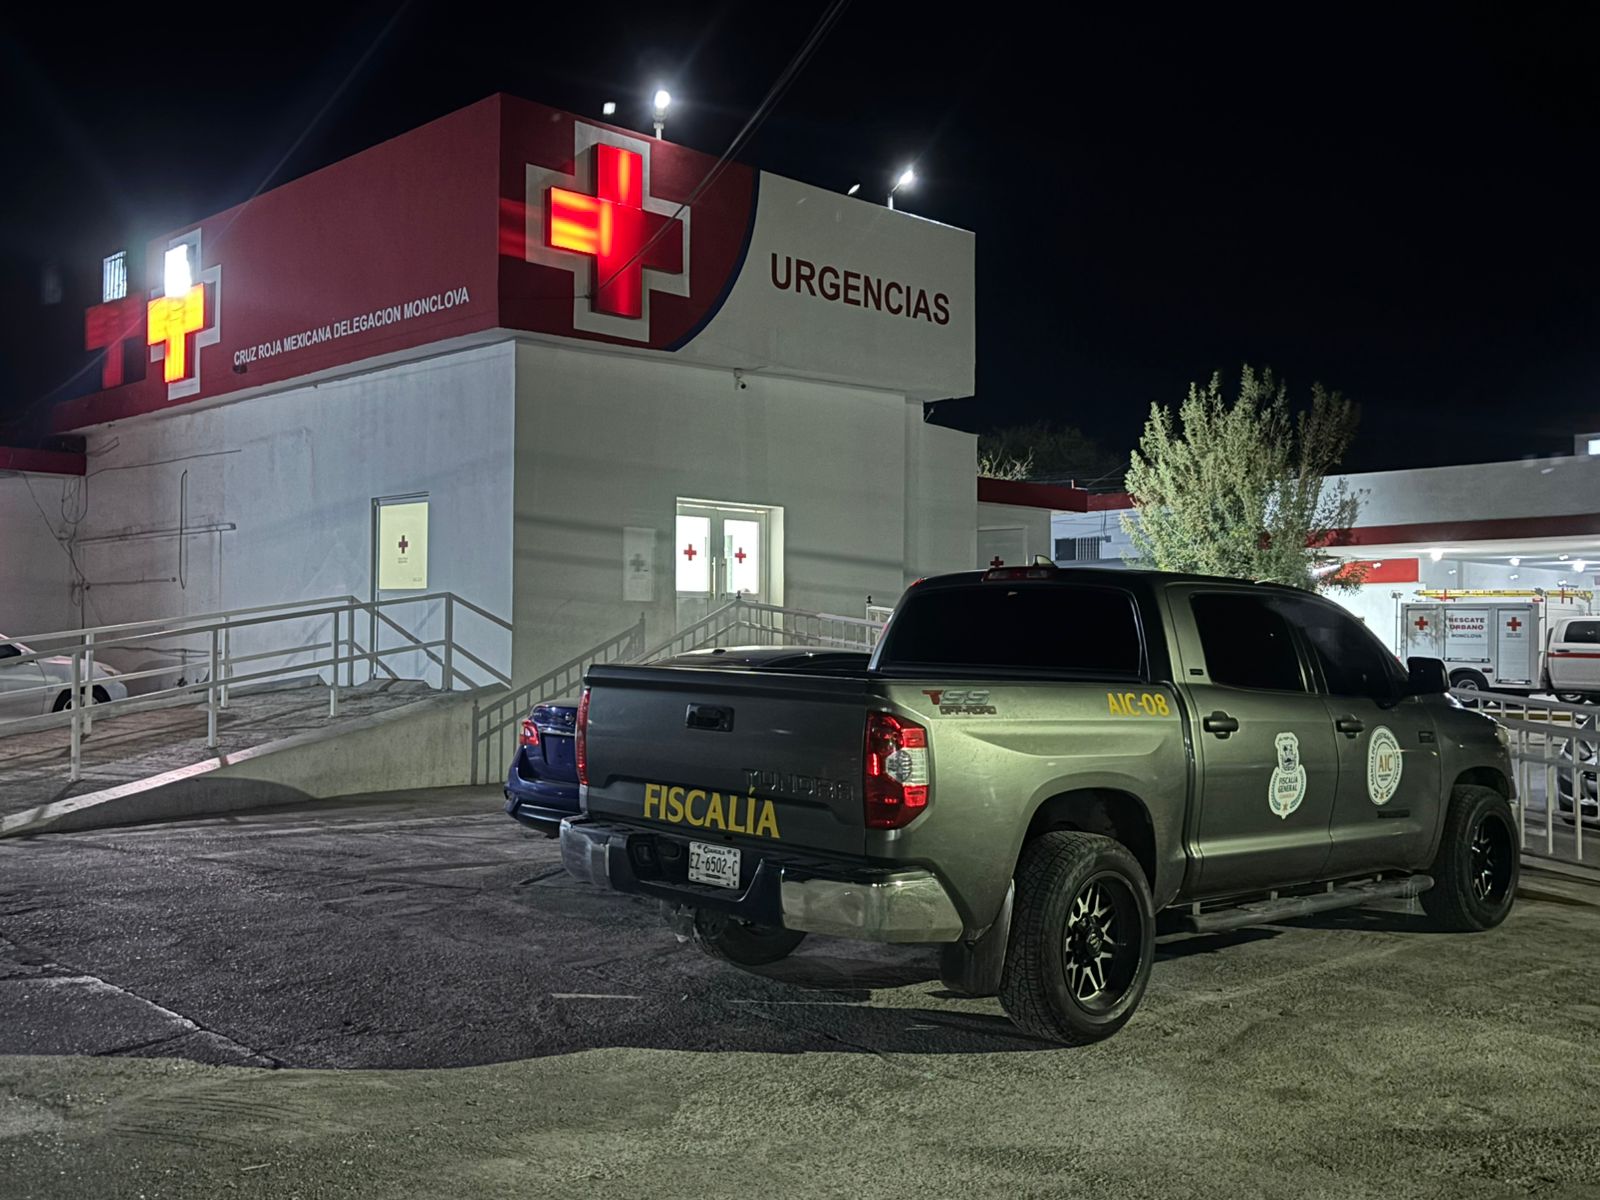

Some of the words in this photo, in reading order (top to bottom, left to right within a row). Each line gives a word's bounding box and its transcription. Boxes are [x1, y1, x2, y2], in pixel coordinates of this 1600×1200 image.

[771, 252, 950, 326] URGENCIAS
[233, 346, 257, 366] CRUZ
[258, 341, 283, 359] ROJA
[283, 325, 332, 352] MEXICANA
[333, 305, 402, 338] DELEGACION
[403, 286, 470, 319] MONCLOVA
[921, 690, 991, 706] TSS
[1107, 692, 1170, 717] AIC-08
[1378, 754, 1393, 772] AIC
[643, 783, 781, 839] FISCALÍA
[689, 852, 738, 877] EZ-6502-C
